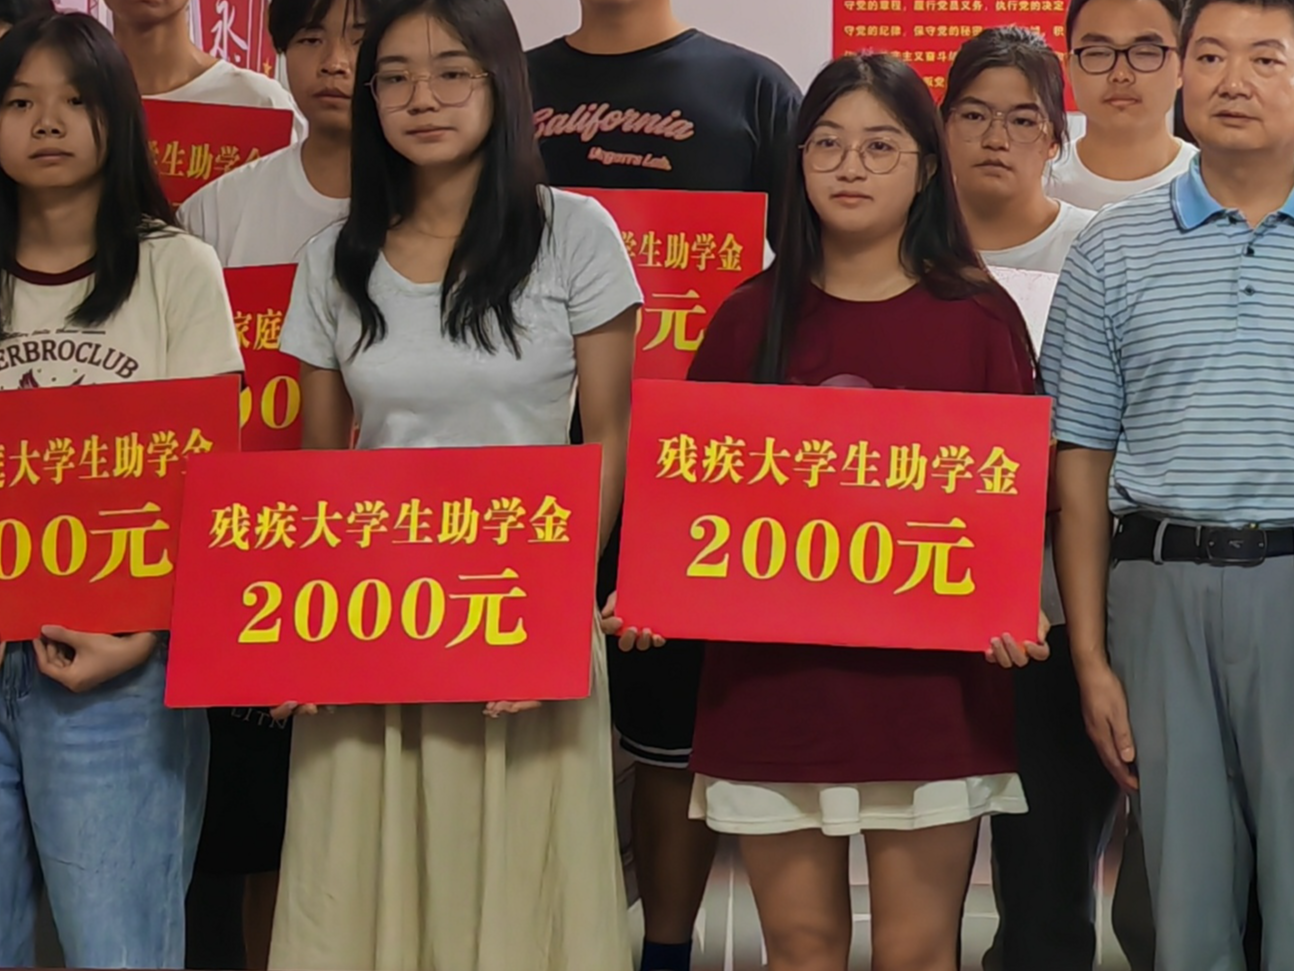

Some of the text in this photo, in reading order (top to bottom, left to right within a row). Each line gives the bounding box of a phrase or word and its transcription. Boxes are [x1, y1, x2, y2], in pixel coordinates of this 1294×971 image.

[637, 289, 706, 352] 元
[655, 432, 1021, 496] 残疾大学生助学金
[209, 494, 573, 552] 残疾大学生助学金
[685, 513, 977, 597] 2000元
[237, 566, 529, 648] 2000元
